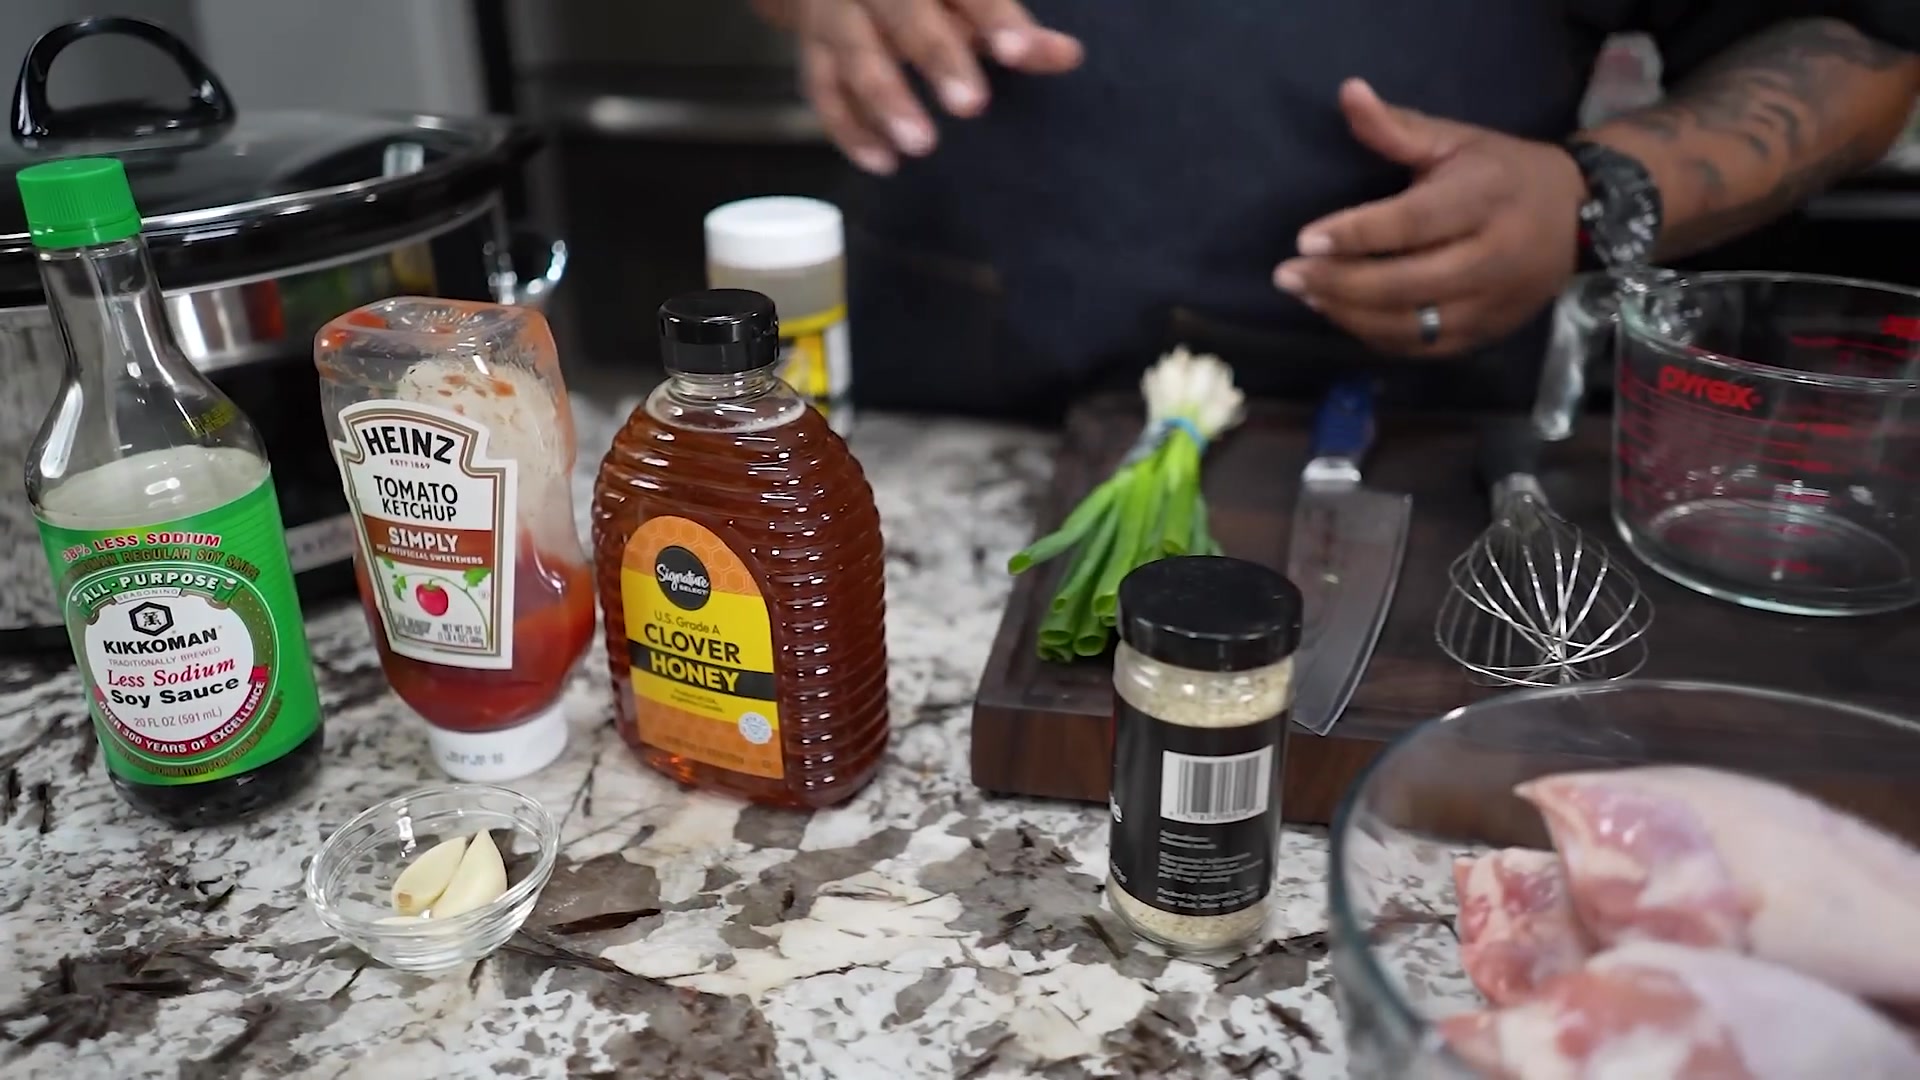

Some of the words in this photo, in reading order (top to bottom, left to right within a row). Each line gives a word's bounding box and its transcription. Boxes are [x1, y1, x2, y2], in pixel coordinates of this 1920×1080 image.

[1659, 364, 1753, 411] pyrex
[362, 426, 455, 464] HEINZ
[411, 460, 430, 470] 1869
[373, 475, 458, 505] TOMATO
[381, 498, 457, 522] KETCHUP
[63, 544, 92, 563] 38%
[94, 534, 139, 552] LESS
[146, 532, 221, 548] SODIUM
[388, 526, 458, 553] SIMPLY
[121, 548, 191, 564] REGULAR
[197, 549, 225, 564] SOY
[387, 546, 428, 561] ARTIFICIAL
[429, 553, 483, 565] SWEETENERS
[656, 563, 709, 591] Signature
[679, 584, 708, 596] SELECT
[117, 588, 178, 601] SEASONING
[654, 609, 674, 625] U.S.
[676, 616, 710, 634] Grade
[711, 625, 721, 635] A
[103, 627, 218, 655] KIKKOMAN
[644, 623, 741, 664] CLOVER
[109, 657, 177, 668] TRADITIONALLY
[180, 646, 221, 662] BREWED
[107, 669, 145, 688] Less
[153, 658, 235, 687] Sodium
[650, 651, 740, 693] HONEY
[110, 689, 151, 709] Soy
[159, 677, 239, 704] Sauce
[99, 701, 122, 730] OVER
[122, 728, 143, 744] 300
[145, 740, 187, 754] YEARS
[190, 739, 208, 751] OF
[210, 681, 266, 744] EXCELLENCE
[134, 717, 145, 728] 20
[148, 717, 159, 728] FL
[161, 715, 176, 727] OZ
[178, 711, 200, 727] (591
[202, 706, 223, 721] mL)
